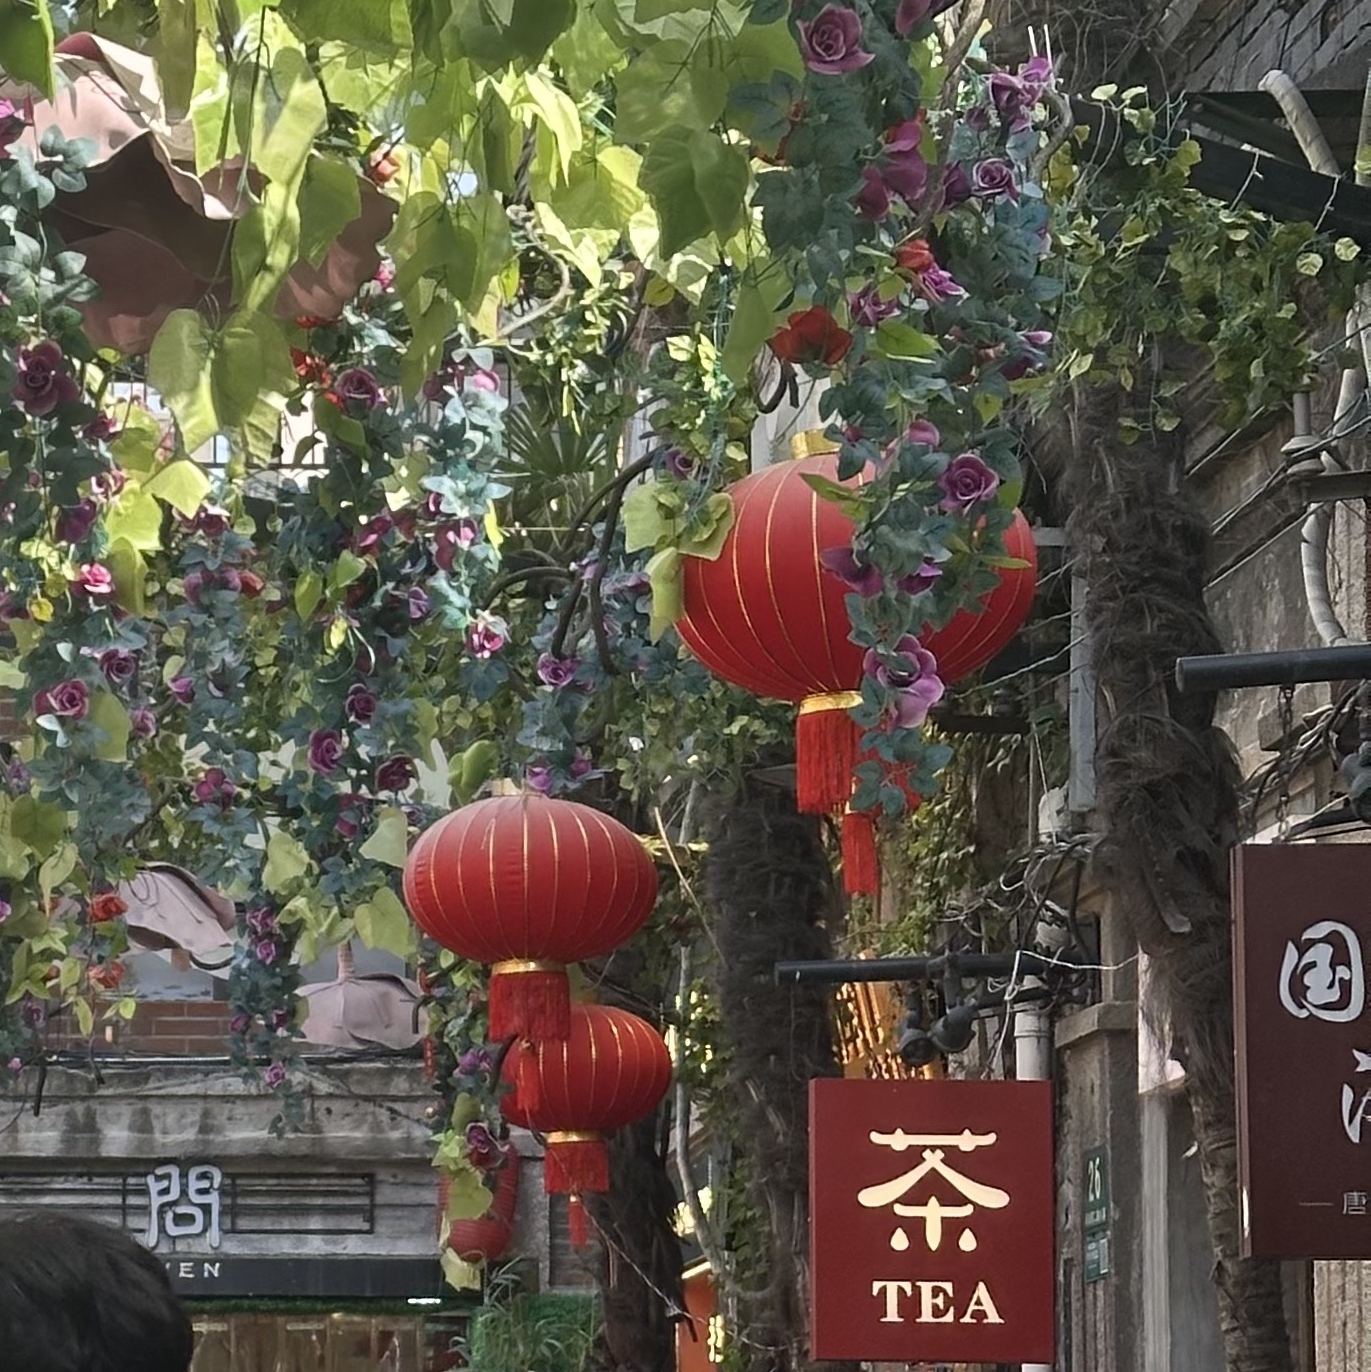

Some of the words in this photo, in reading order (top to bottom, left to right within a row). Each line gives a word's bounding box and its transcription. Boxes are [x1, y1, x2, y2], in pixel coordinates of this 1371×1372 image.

[857, 1127, 1011, 1252] 茶
[165, 1261, 222, 1279] EN
[871, 1280, 1006, 1325] TEA
